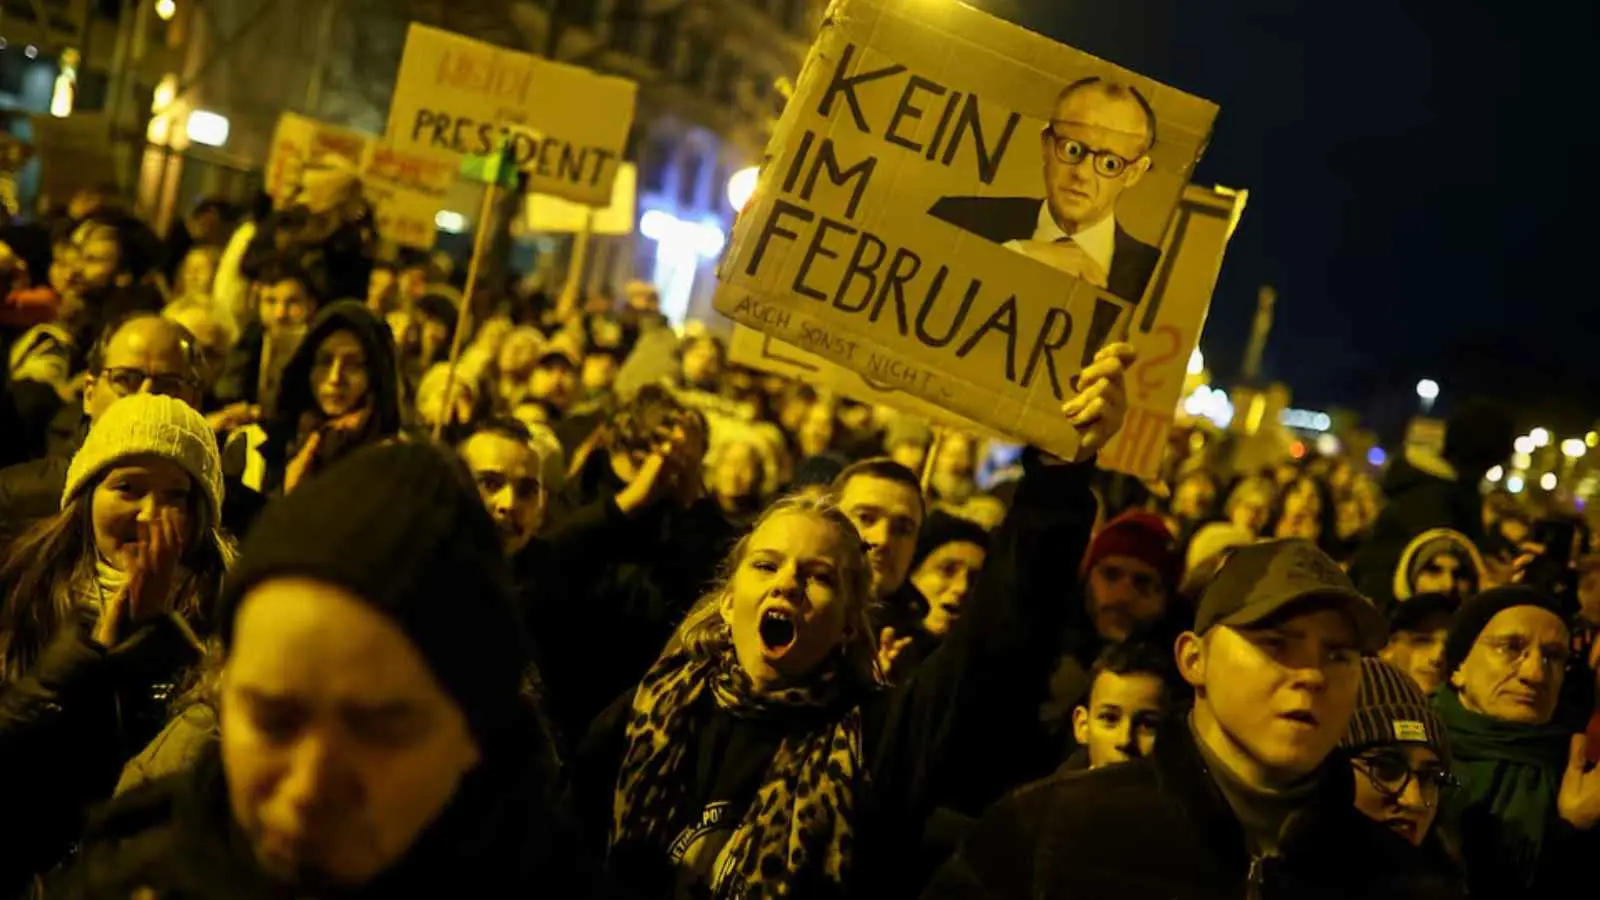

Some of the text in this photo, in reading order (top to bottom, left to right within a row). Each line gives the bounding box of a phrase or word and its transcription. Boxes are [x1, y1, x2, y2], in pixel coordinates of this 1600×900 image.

[817, 43, 1021, 185] KEIN
[781, 129, 878, 220] IM
[733, 296, 791, 329] AUCH
[800, 319, 860, 360] SONST
[868, 353, 937, 390] NICHT
[745, 199, 1124, 401] FEBRUAR!
